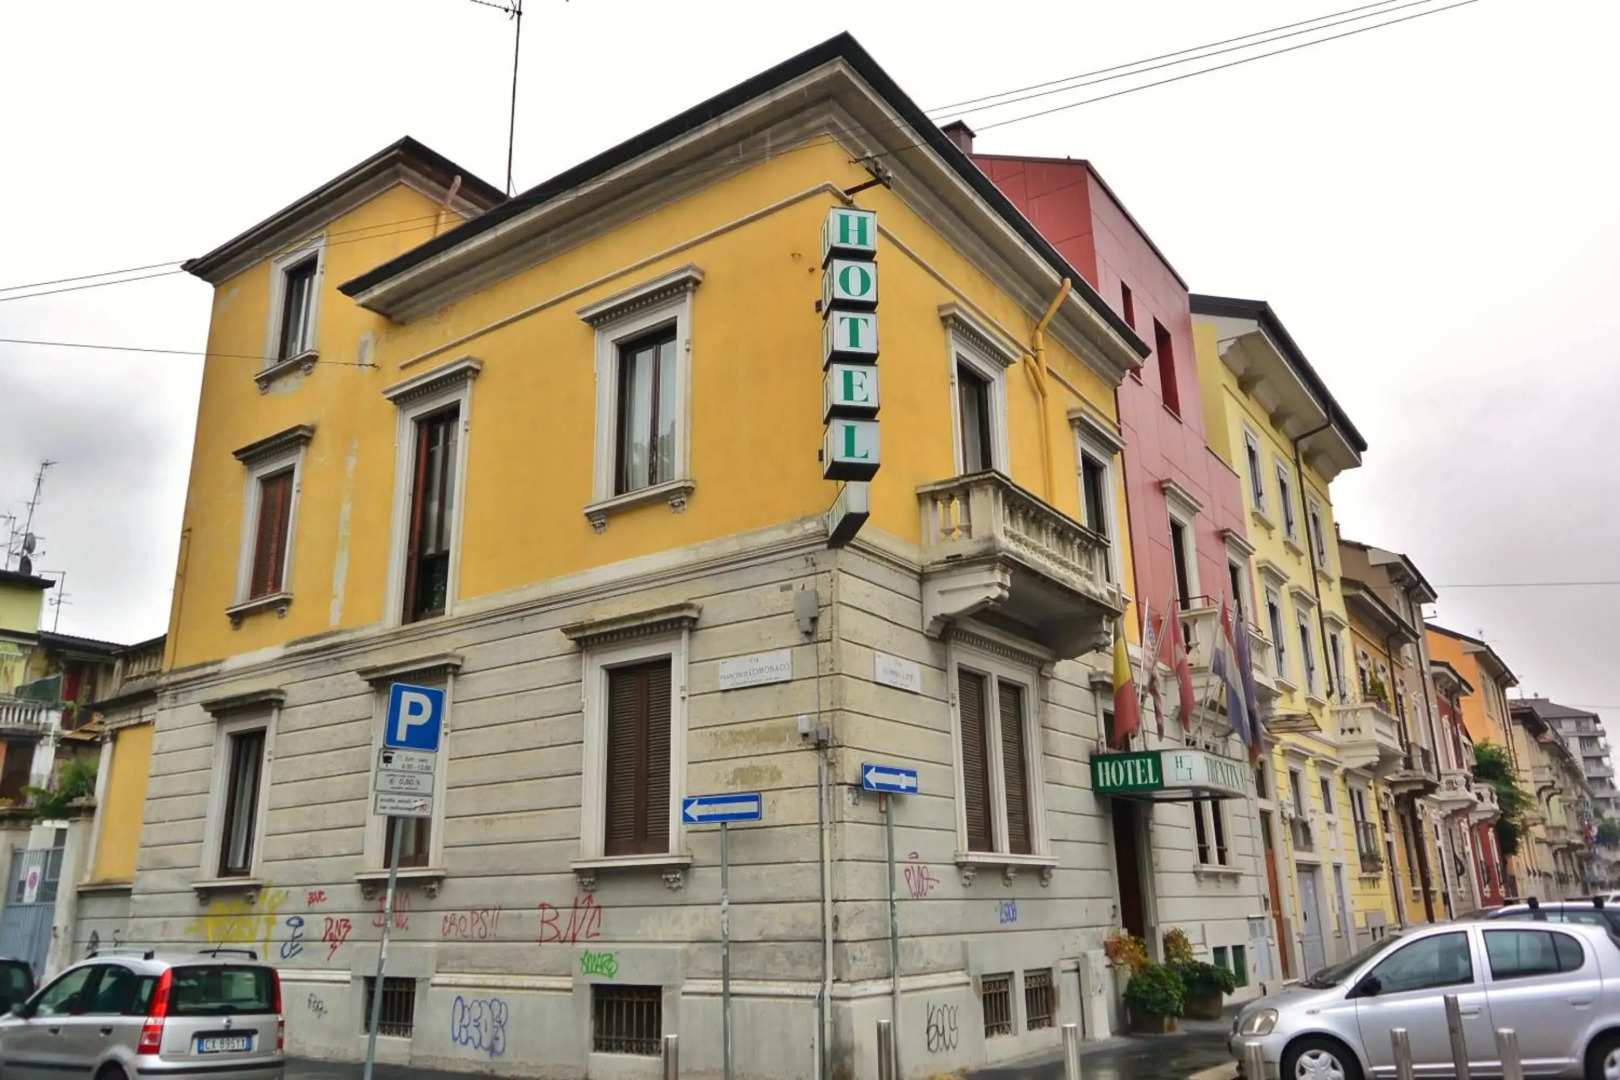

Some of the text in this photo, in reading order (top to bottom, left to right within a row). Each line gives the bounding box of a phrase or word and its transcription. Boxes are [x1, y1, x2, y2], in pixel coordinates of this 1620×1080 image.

[837, 213, 872, 460] HOTEL
[748, 662, 790, 676] LOMONACO
[396, 691, 432, 742] P
[1097, 758, 1159, 787] HOTEL
